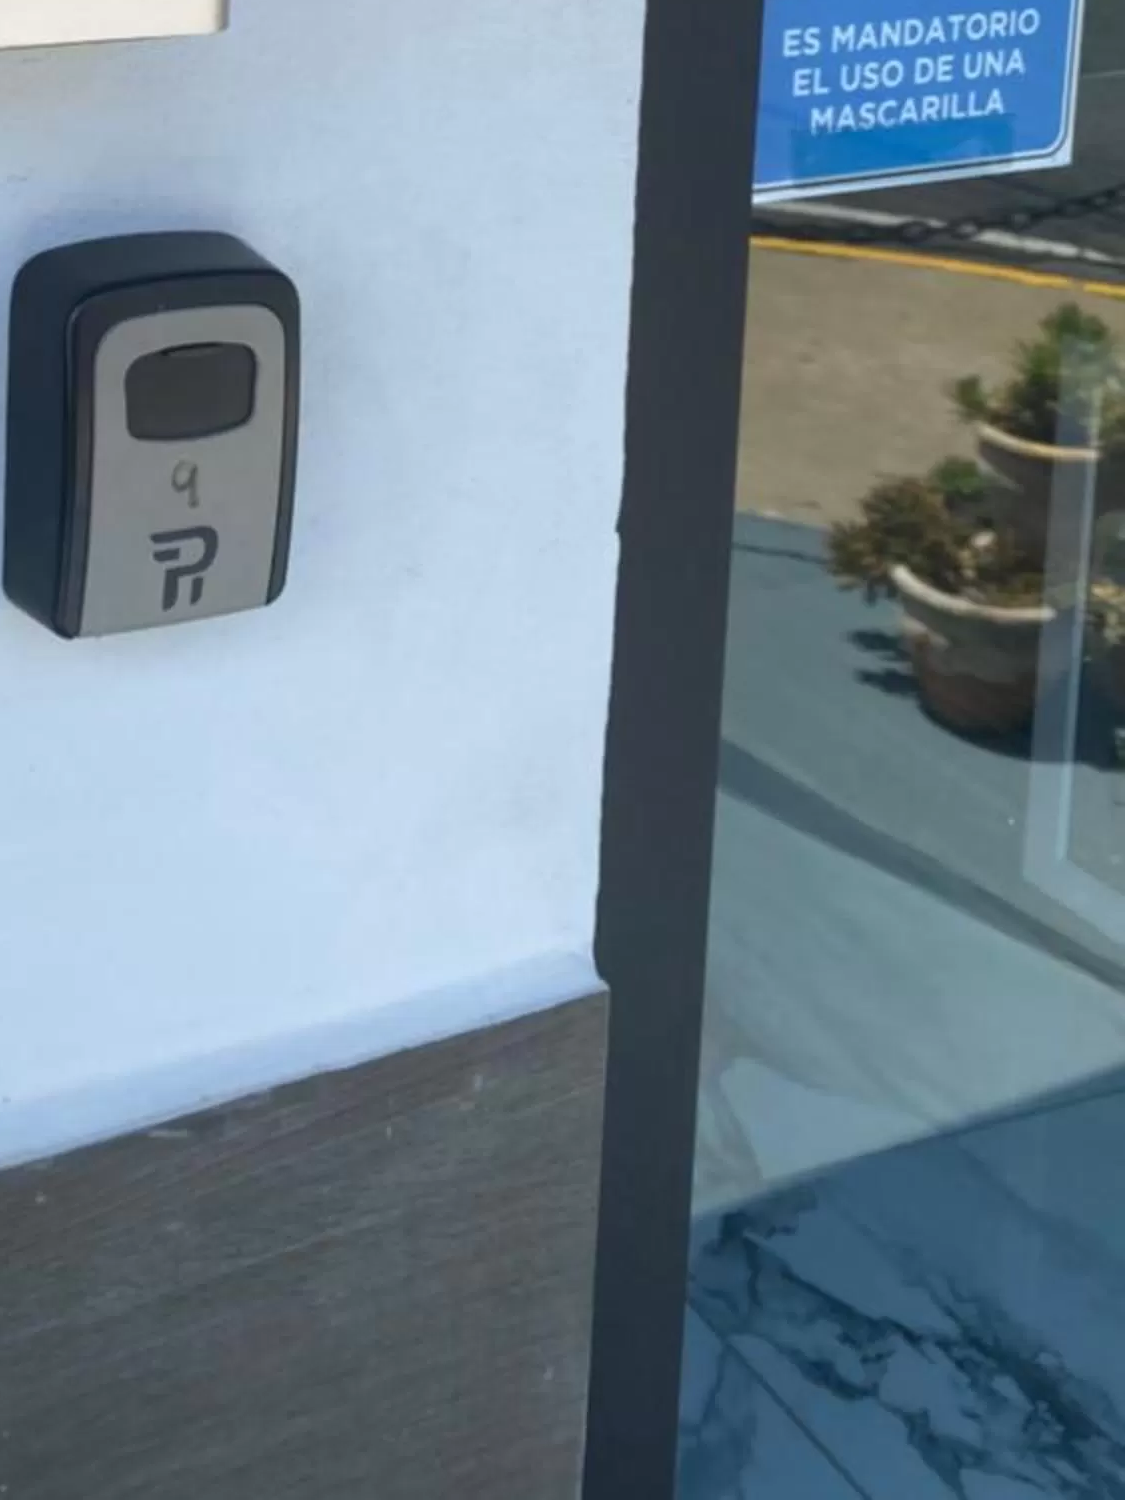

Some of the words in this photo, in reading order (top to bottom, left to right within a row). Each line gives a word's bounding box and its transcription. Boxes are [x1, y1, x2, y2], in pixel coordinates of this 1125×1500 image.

[782, 26, 821, 58] ES
[831, 7, 1041, 53] MANDATORIO
[792, 67, 830, 97] EL
[840, 59, 904, 92] USO
[914, 54, 955, 85] DE
[963, 47, 1025, 80] UNA
[810, 88, 1005, 137] MASCARILLA
